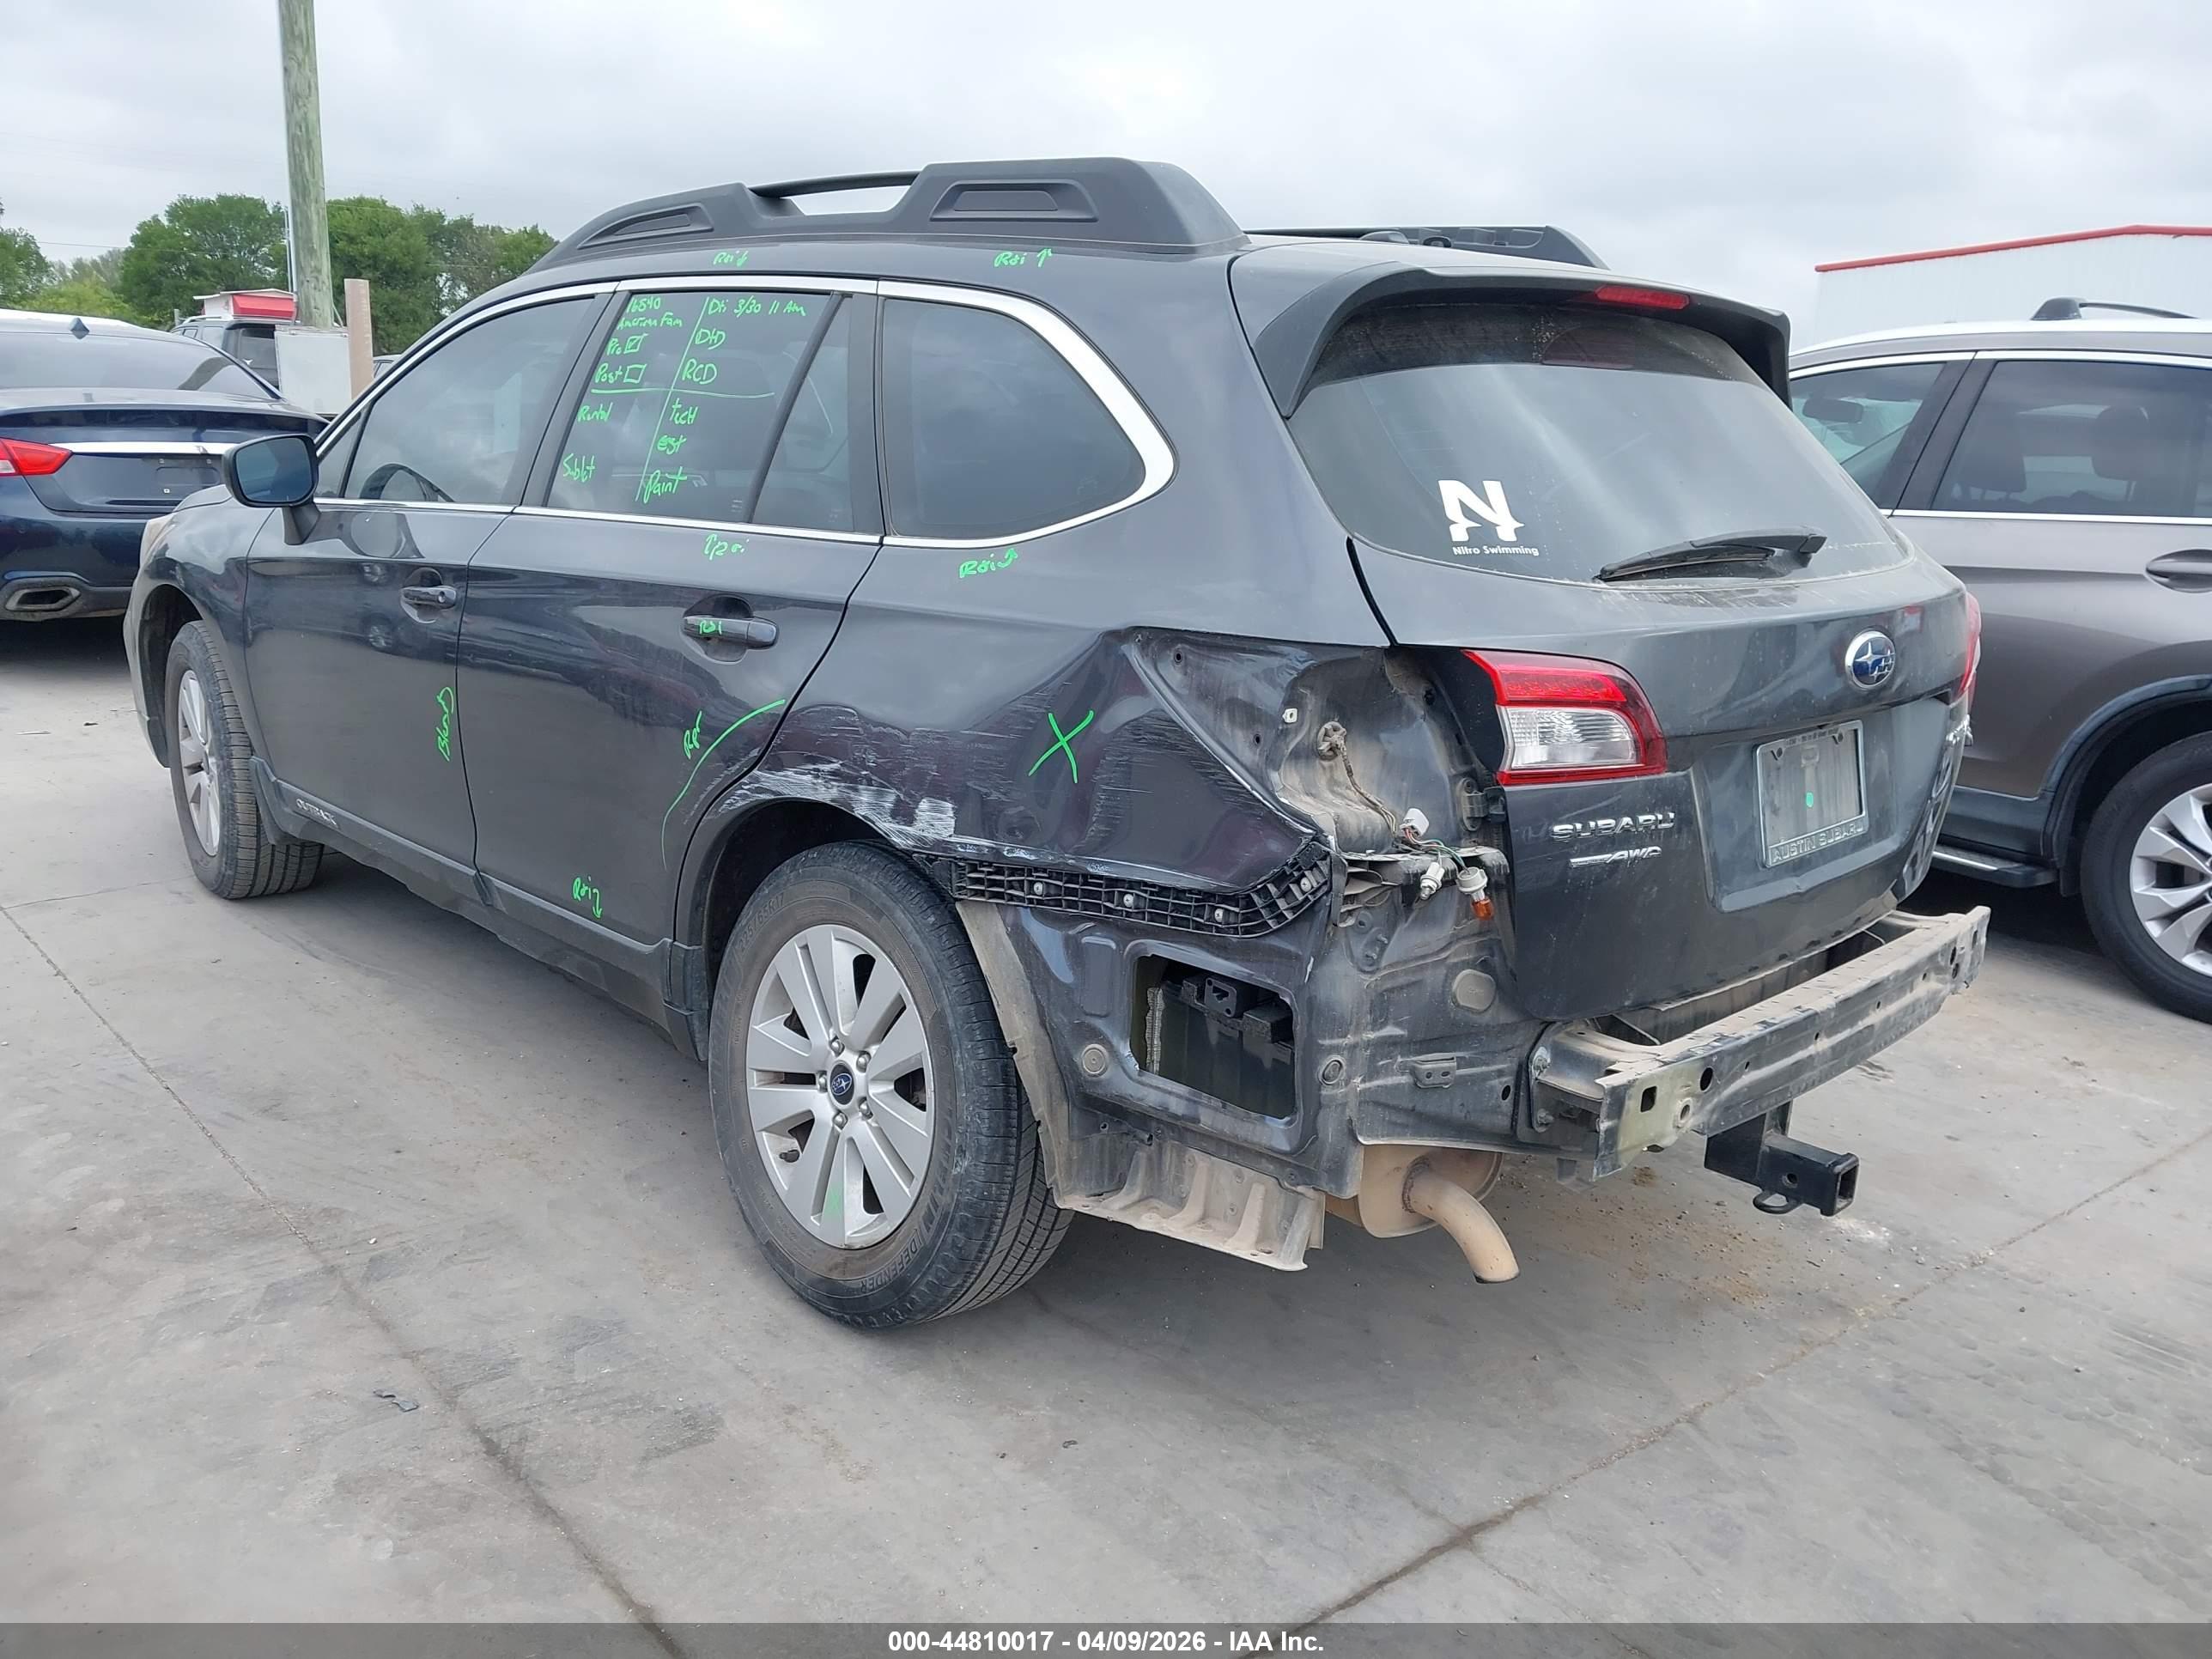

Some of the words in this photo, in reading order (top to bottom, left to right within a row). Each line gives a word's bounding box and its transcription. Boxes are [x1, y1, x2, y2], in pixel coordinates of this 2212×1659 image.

[733, 295, 762, 318] 3/30
[594, 362, 623, 384] Post
[682, 358, 718, 385] RCD
[1452, 546, 1480, 556] Nitro
[1482, 545, 1540, 556] Swimming
[1550, 811, 1675, 842] SUBARU
[1771, 835, 1816, 862] AUSTIN
[1819, 821, 1864, 847] SUBARU
[1606, 846, 1662, 863] AWD
